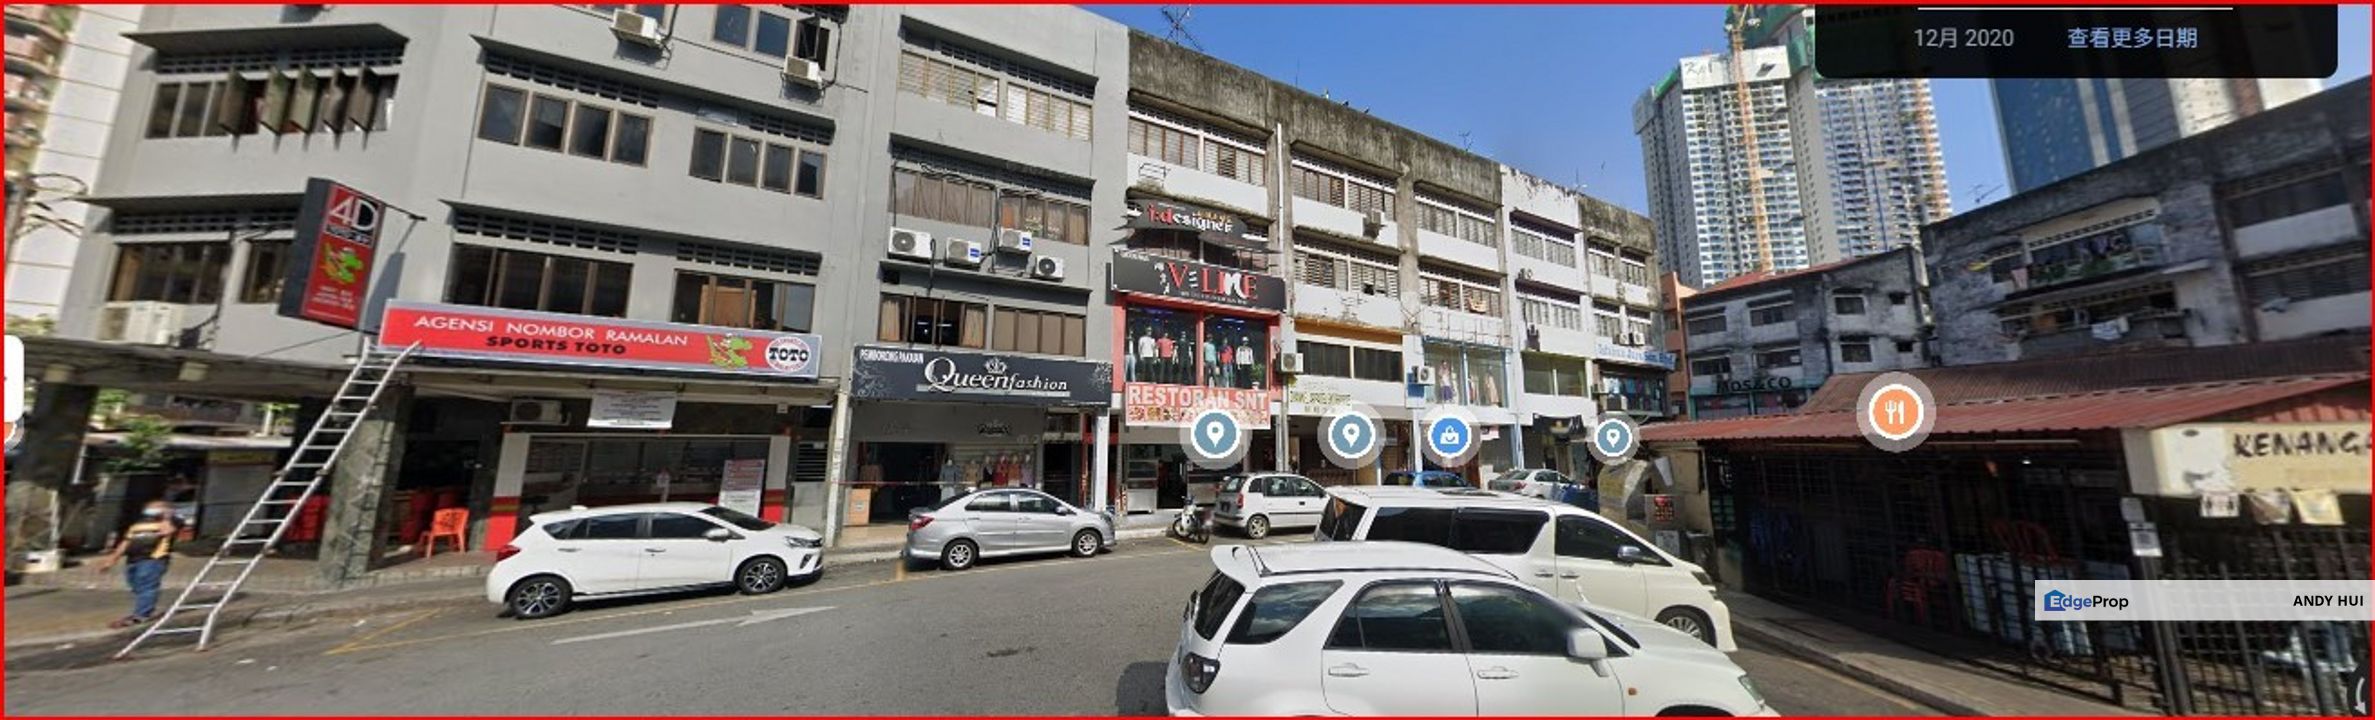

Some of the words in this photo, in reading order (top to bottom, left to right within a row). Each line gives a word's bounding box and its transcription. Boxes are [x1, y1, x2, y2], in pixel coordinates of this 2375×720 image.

[329, 196, 378, 231] 4D
[413, 316, 494, 332] AGENSI
[506, 322, 595, 340] NOMBOR
[605, 329, 688, 346] RAMALAN
[486, 336, 568, 351] SPORTS
[575, 342, 627, 355] TOTO
[768, 347, 810, 362] TOTO
[1128, 384, 1230, 408] RESTORAN
[1234, 391, 1268, 410] SNT
